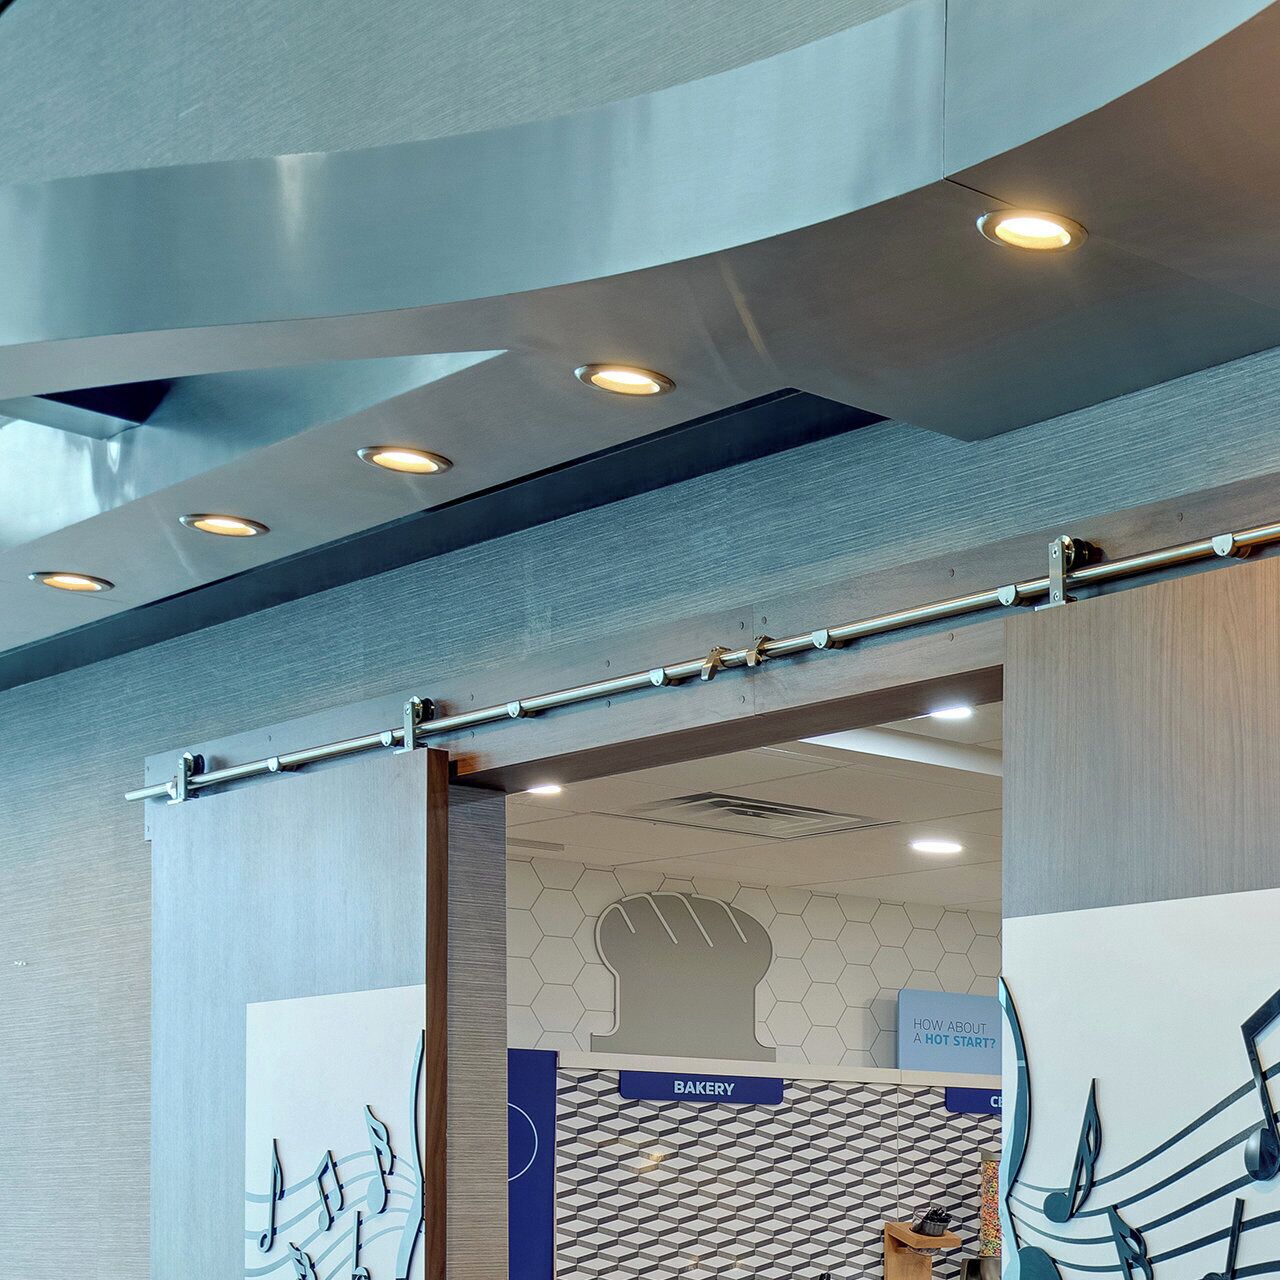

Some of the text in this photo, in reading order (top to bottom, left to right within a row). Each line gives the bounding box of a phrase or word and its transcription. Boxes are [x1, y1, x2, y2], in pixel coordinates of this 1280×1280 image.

[913, 1018, 987, 1035] HOW ABOUT
[913, 1032, 996, 1049] A HOT START?
[674, 1080, 735, 1096] BAKERY
